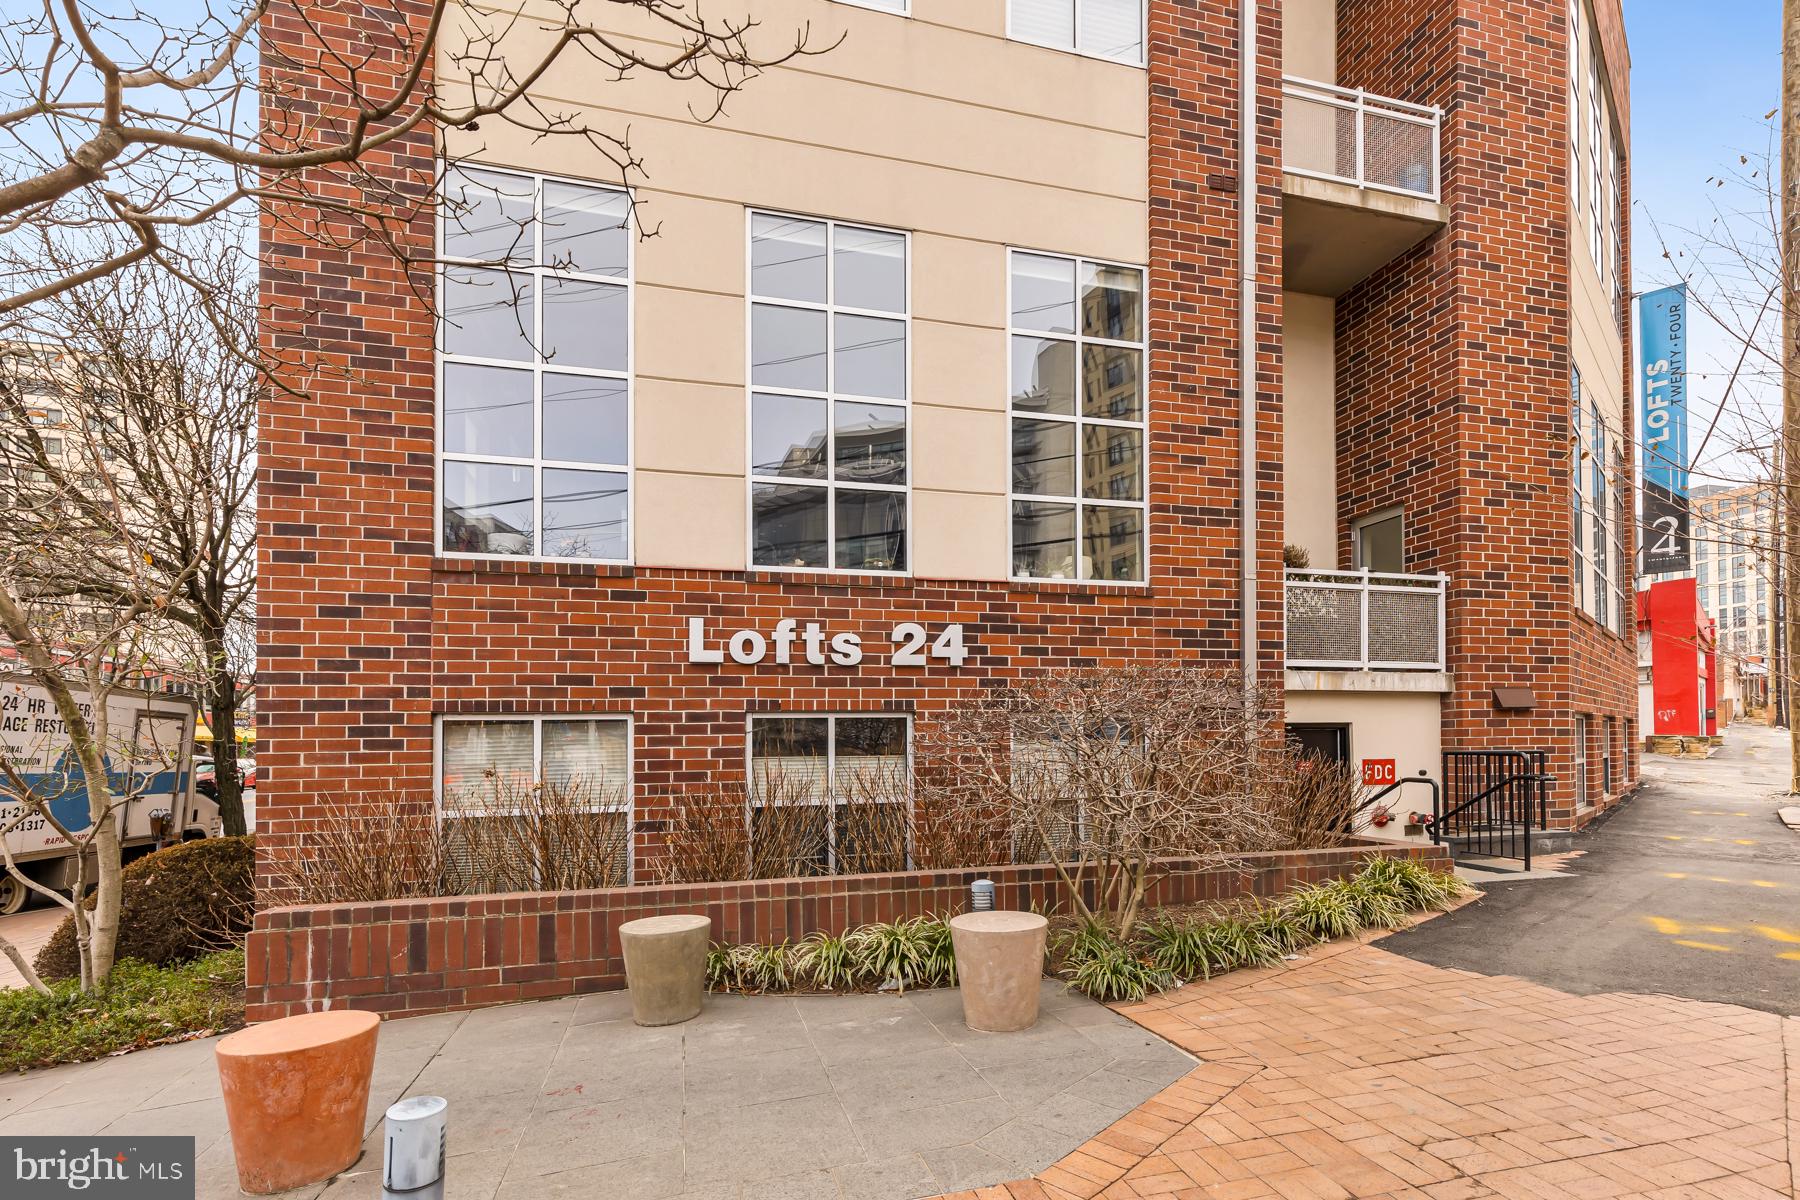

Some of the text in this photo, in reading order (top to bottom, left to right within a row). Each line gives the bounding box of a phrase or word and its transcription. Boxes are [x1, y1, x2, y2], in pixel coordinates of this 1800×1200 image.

[1647, 359, 1670, 445] LOFTS
[688, 617, 969, 667] Lofts 24
[2, 695, 19, 712] 24
[27, 698, 46, 714] HR
